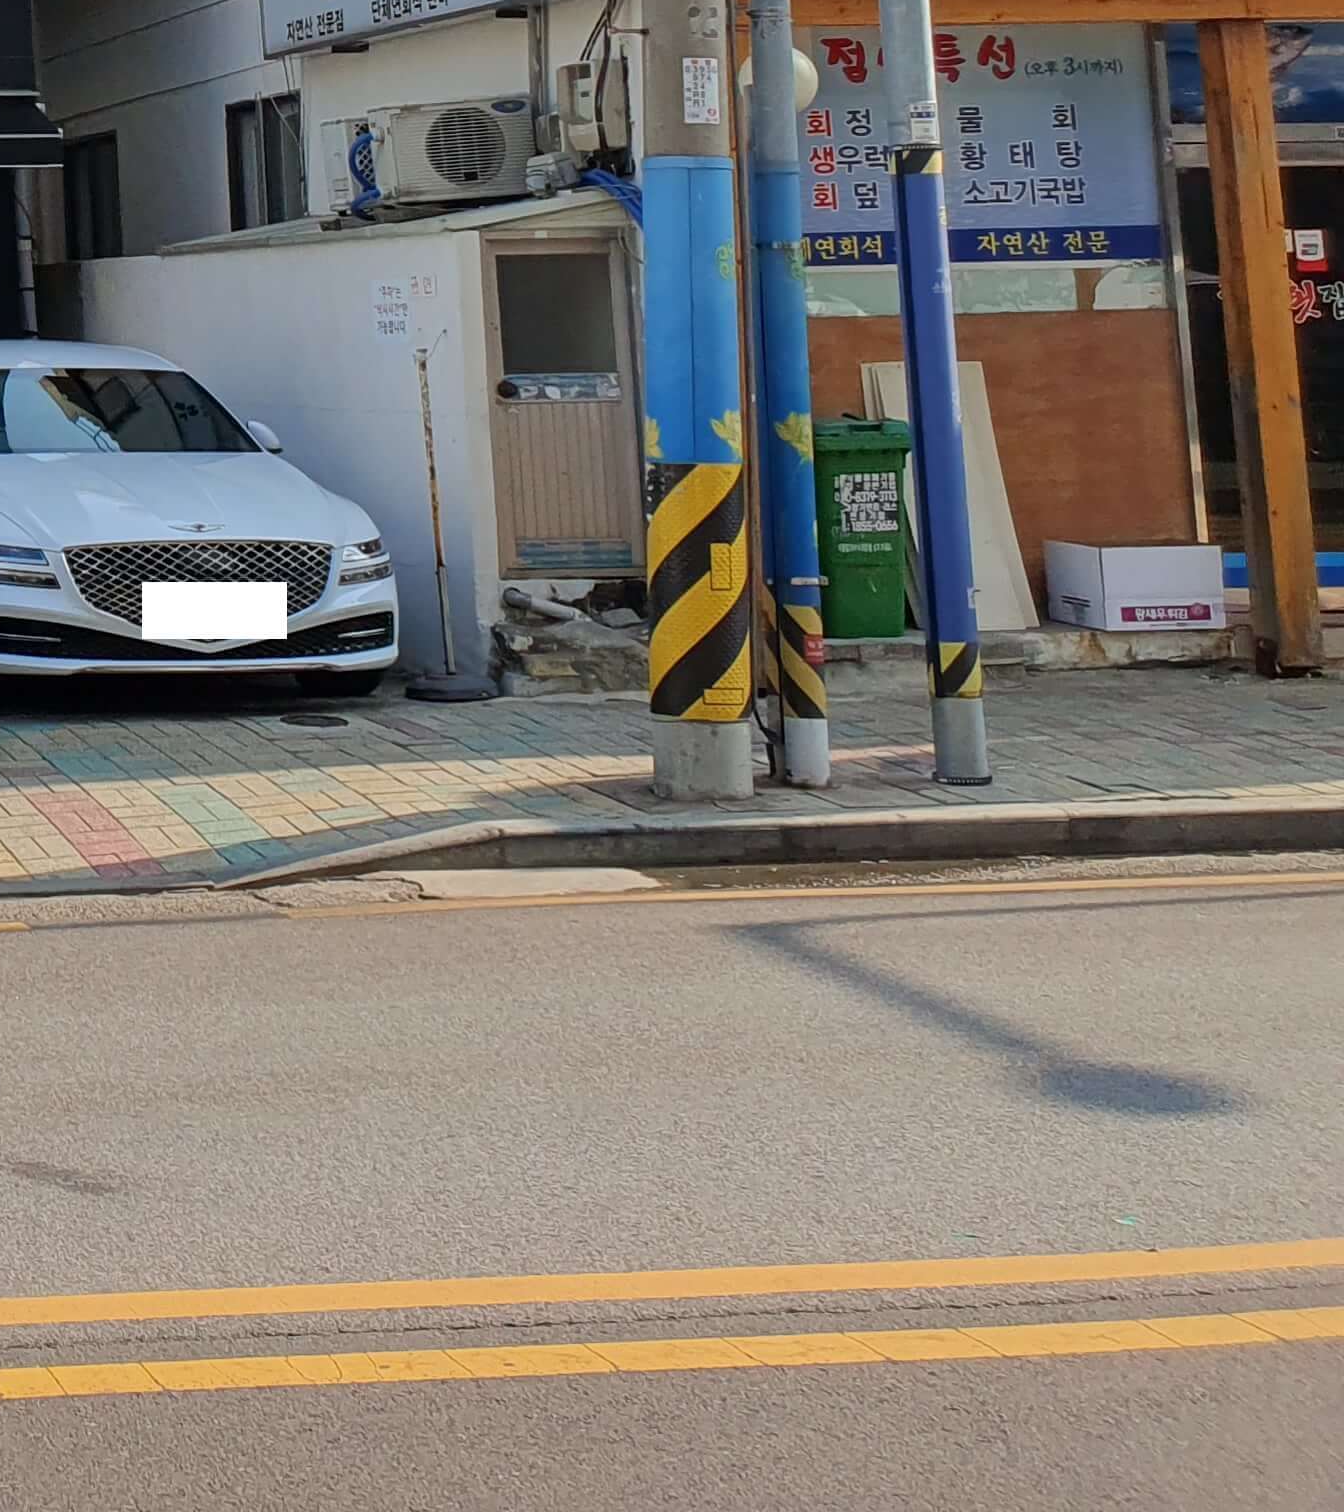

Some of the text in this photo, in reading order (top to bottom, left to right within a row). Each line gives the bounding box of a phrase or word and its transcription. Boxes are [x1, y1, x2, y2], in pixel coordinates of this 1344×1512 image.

[316, 8, 345, 37] 전문점
[960, 141, 1082, 172] 황태탕
[964, 176, 1086, 206] 소고기국밥
[978, 232, 1050, 256] 자연산
[1063, 229, 1110, 254] 전문
